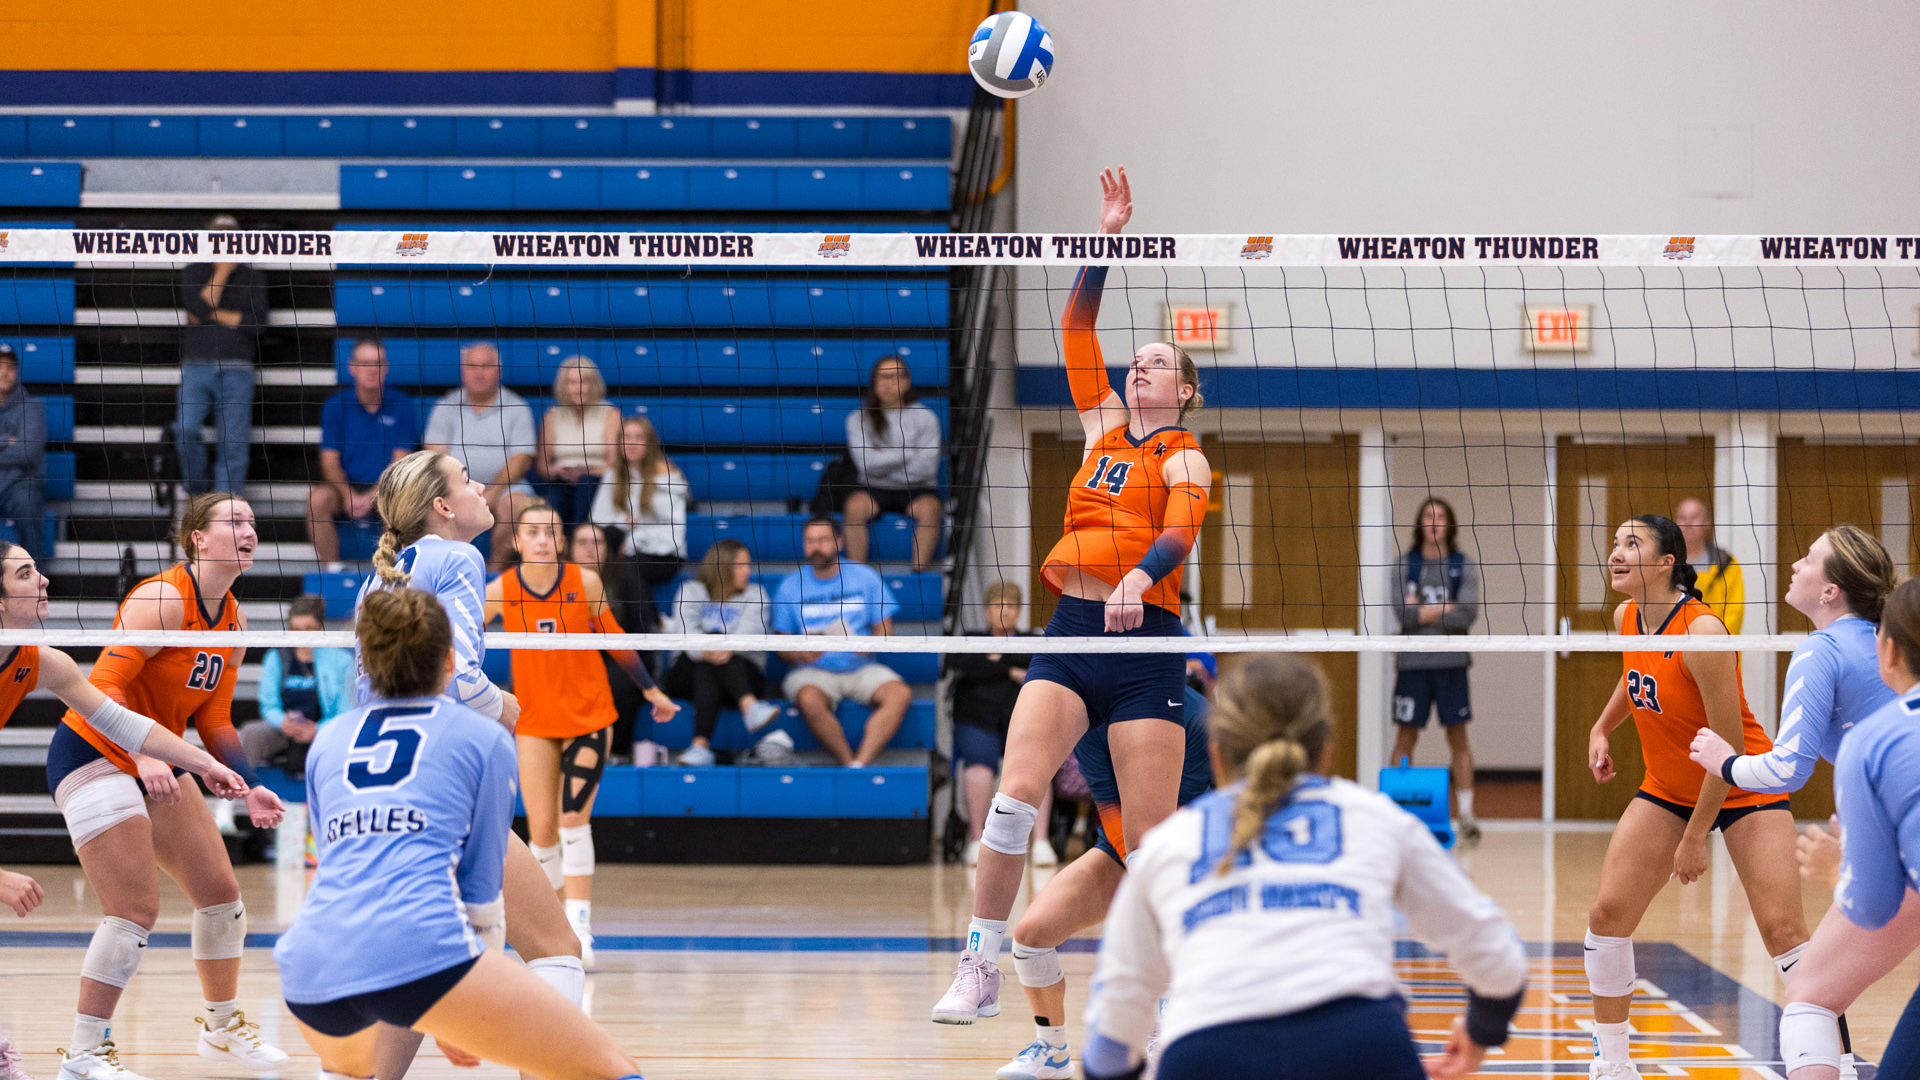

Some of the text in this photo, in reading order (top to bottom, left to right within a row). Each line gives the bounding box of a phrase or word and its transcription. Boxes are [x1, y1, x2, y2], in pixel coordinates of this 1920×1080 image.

[72, 232, 332, 256] WHEATON THUNDER
[492, 234, 754, 258] WHEATON THUNDER
[914, 235, 1176, 259] WHEATON THUNDER
[1337, 236, 1599, 260] WHEATON THUNDER
[1760, 237, 1888, 260] WHEATON
[1176, 309, 1219, 342] EXIT
[1537, 310, 1579, 343] EXIT
[1084, 455, 1134, 496] 14
[13, 667, 31, 683] W
[186, 651, 224, 691] 20
[1627, 668, 1663, 714] 23
[343, 701, 441, 795] 5
[326, 805, 428, 843] BELLES
